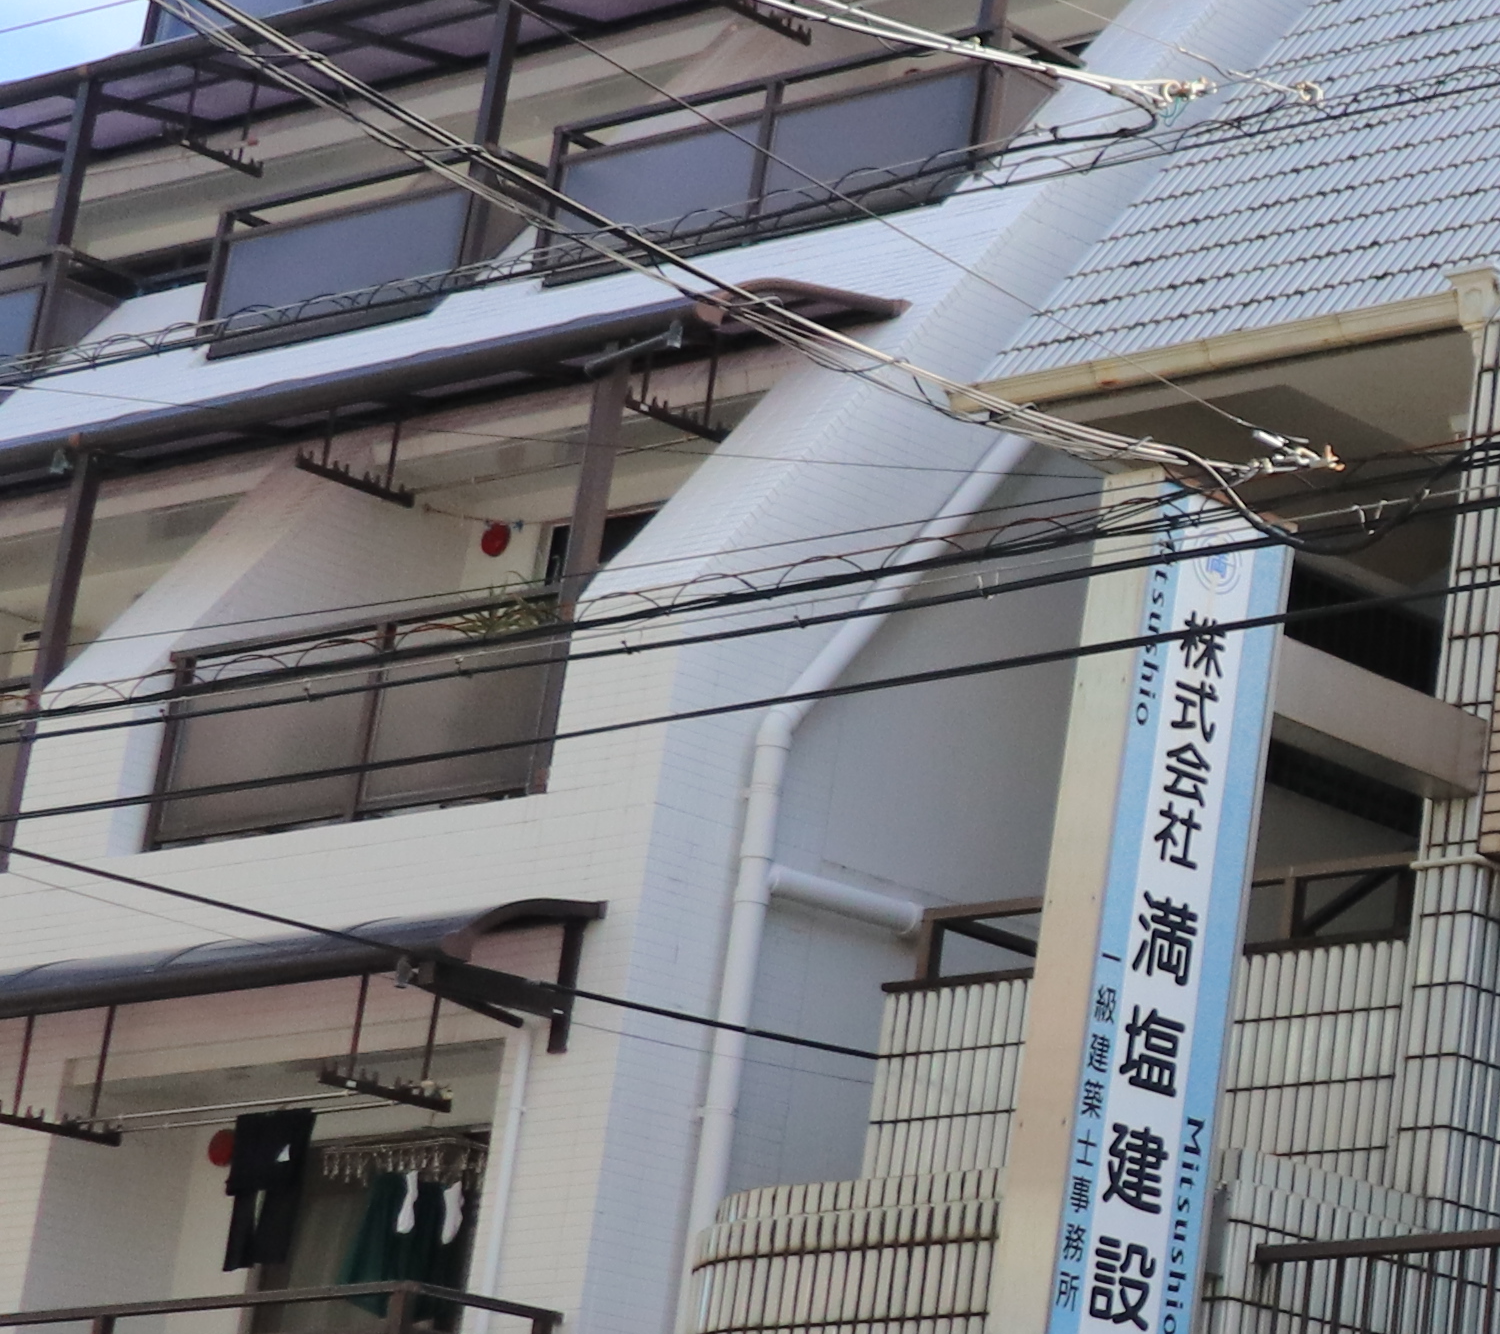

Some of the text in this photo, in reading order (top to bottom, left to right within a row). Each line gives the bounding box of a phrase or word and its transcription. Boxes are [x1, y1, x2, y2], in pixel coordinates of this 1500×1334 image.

[1056, 951, 1122, 1313] 一級建築士事務所
